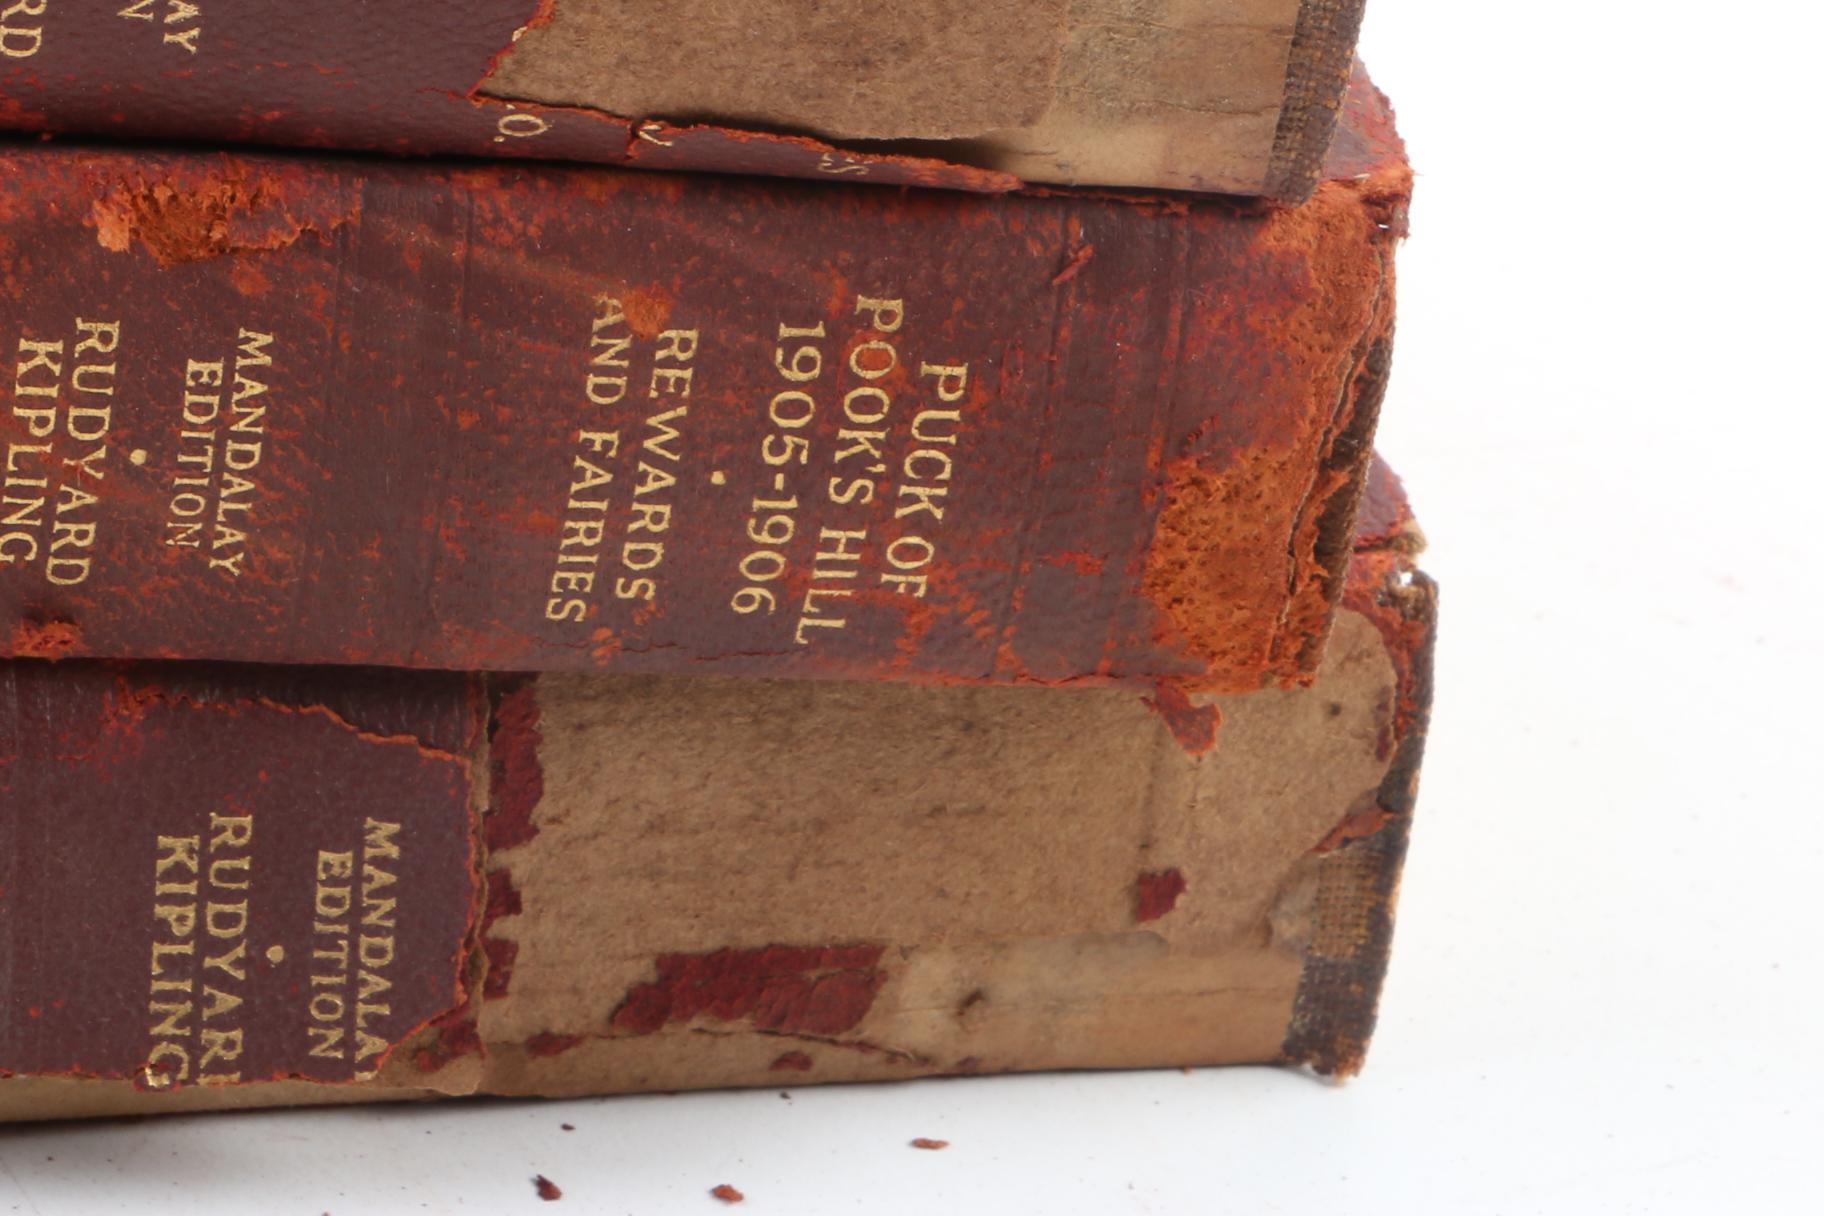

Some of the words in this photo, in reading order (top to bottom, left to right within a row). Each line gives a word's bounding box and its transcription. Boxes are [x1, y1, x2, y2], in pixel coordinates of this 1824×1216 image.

[45, 317, 119, 586] RUDYARD
[165, 357, 224, 548] EDITION
[209, 327, 273, 576] MANDALAY
[585, 294, 633, 405] AND
[828, 294, 904, 505] POOK'S
[893, 361, 968, 524] PUCK
[545, 429, 619, 623] FAIRIES
[615, 328, 698, 601] REWARDS
[730, 321, 825, 615] 1905-1906
[880, 535, 935, 598] OF
[795, 527, 867, 644] HILL
[145, 834, 200, 1088] KIPLING
[307, 850, 353, 1059] EDITION
